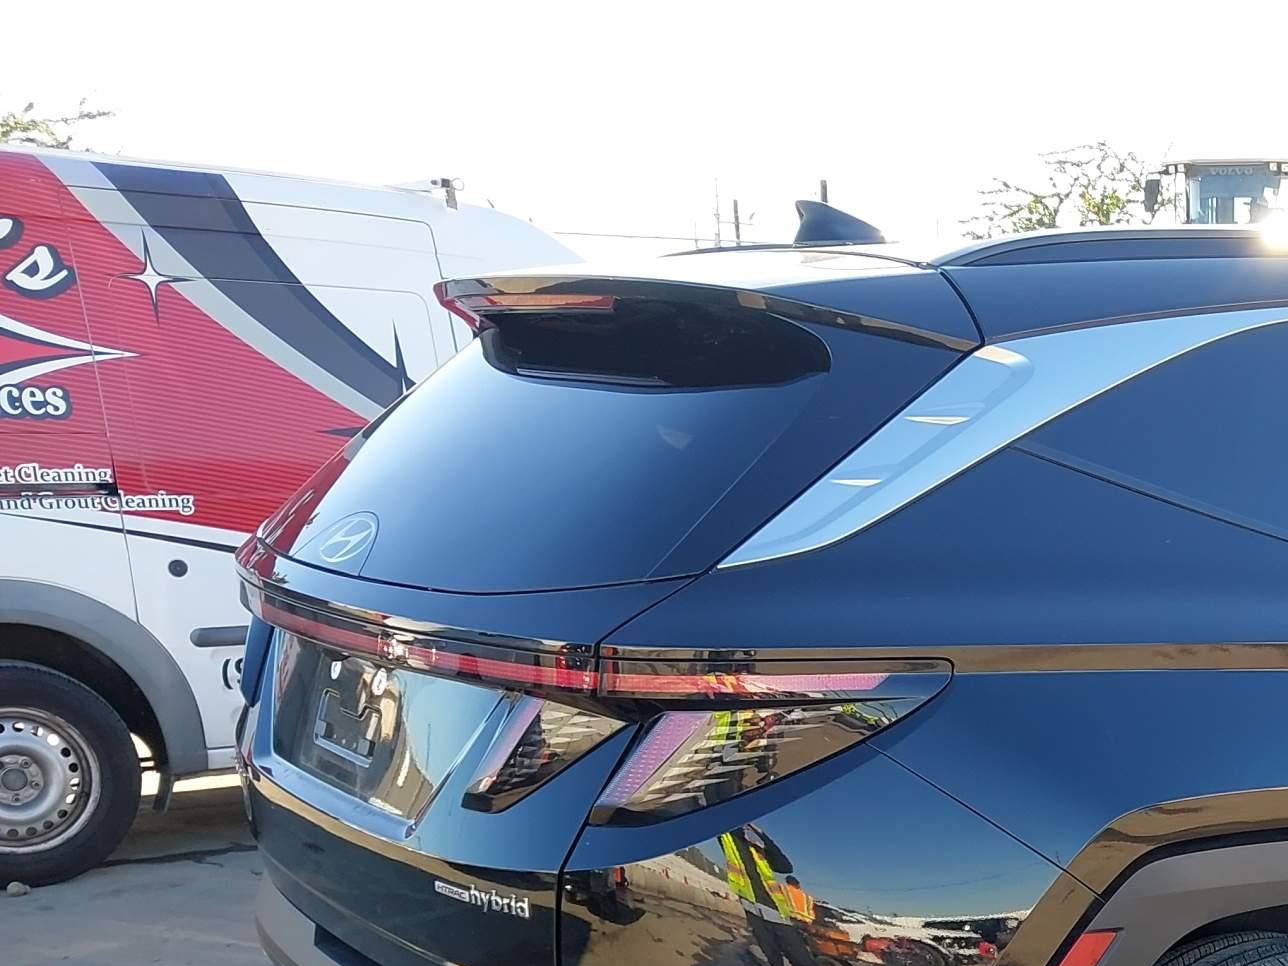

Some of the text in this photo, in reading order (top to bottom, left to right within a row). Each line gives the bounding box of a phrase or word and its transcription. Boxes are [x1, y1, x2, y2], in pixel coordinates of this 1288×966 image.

[0, 386, 67, 416] ces
[18, 465, 111, 483] Cleaning
[39, 495, 98, 510] Grout
[104, 494, 194, 513] Cleaning
[470, 884, 529, 918] hybrid
